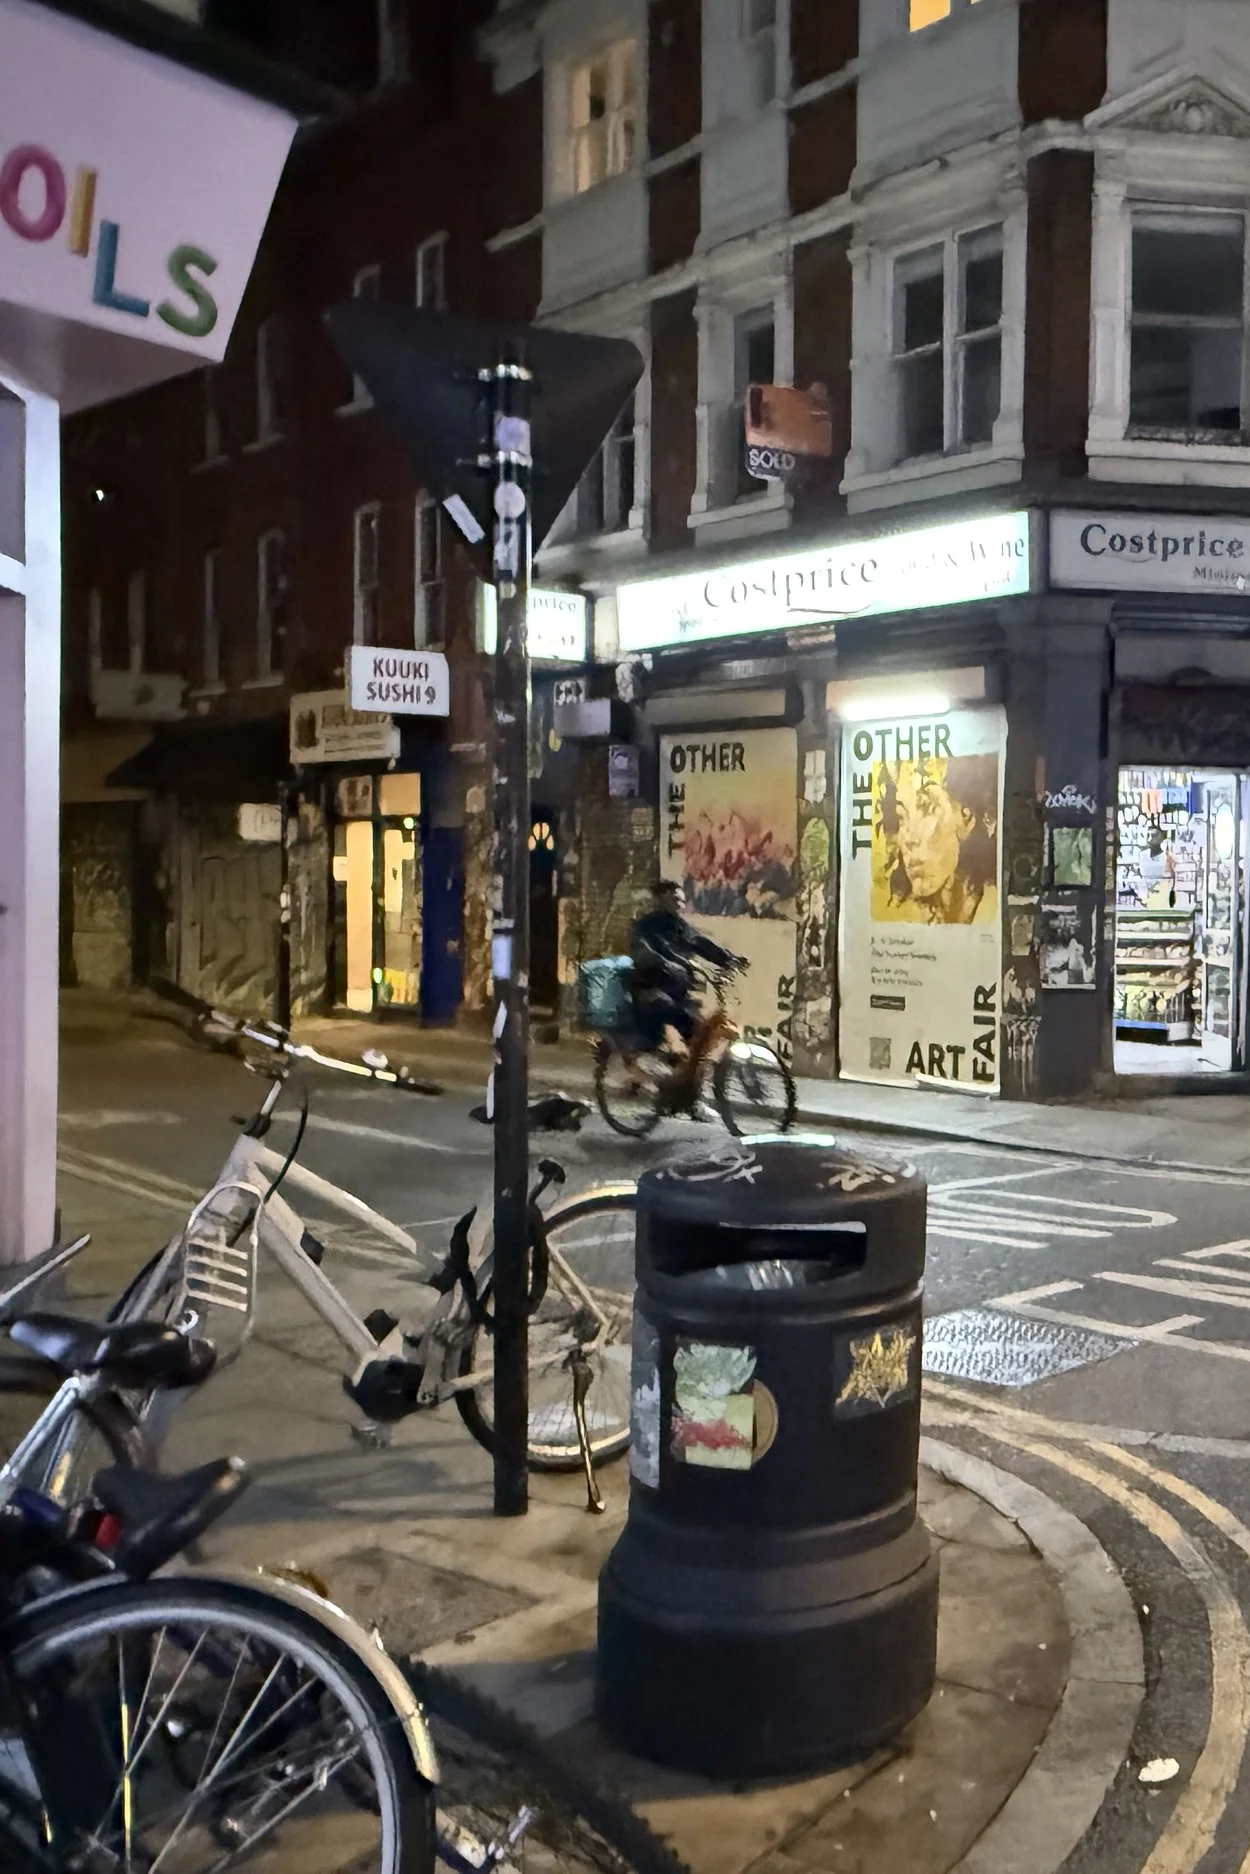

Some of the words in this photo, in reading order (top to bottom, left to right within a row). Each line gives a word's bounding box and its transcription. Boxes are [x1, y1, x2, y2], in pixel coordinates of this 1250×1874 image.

[1080, 523, 1245, 562] Costprice
[703, 557, 878, 608] Costprice
[373, 656, 429, 682] KUUKI
[366, 681, 421, 704] SUSHI
[669, 742, 746, 774] OTHER
[852, 723, 954, 761] OTHER
[667, 781, 686, 858] THE
[851, 770, 874, 861] THE
[972, 981, 998, 1082] FAIR
[905, 1040, 966, 1075] ART
